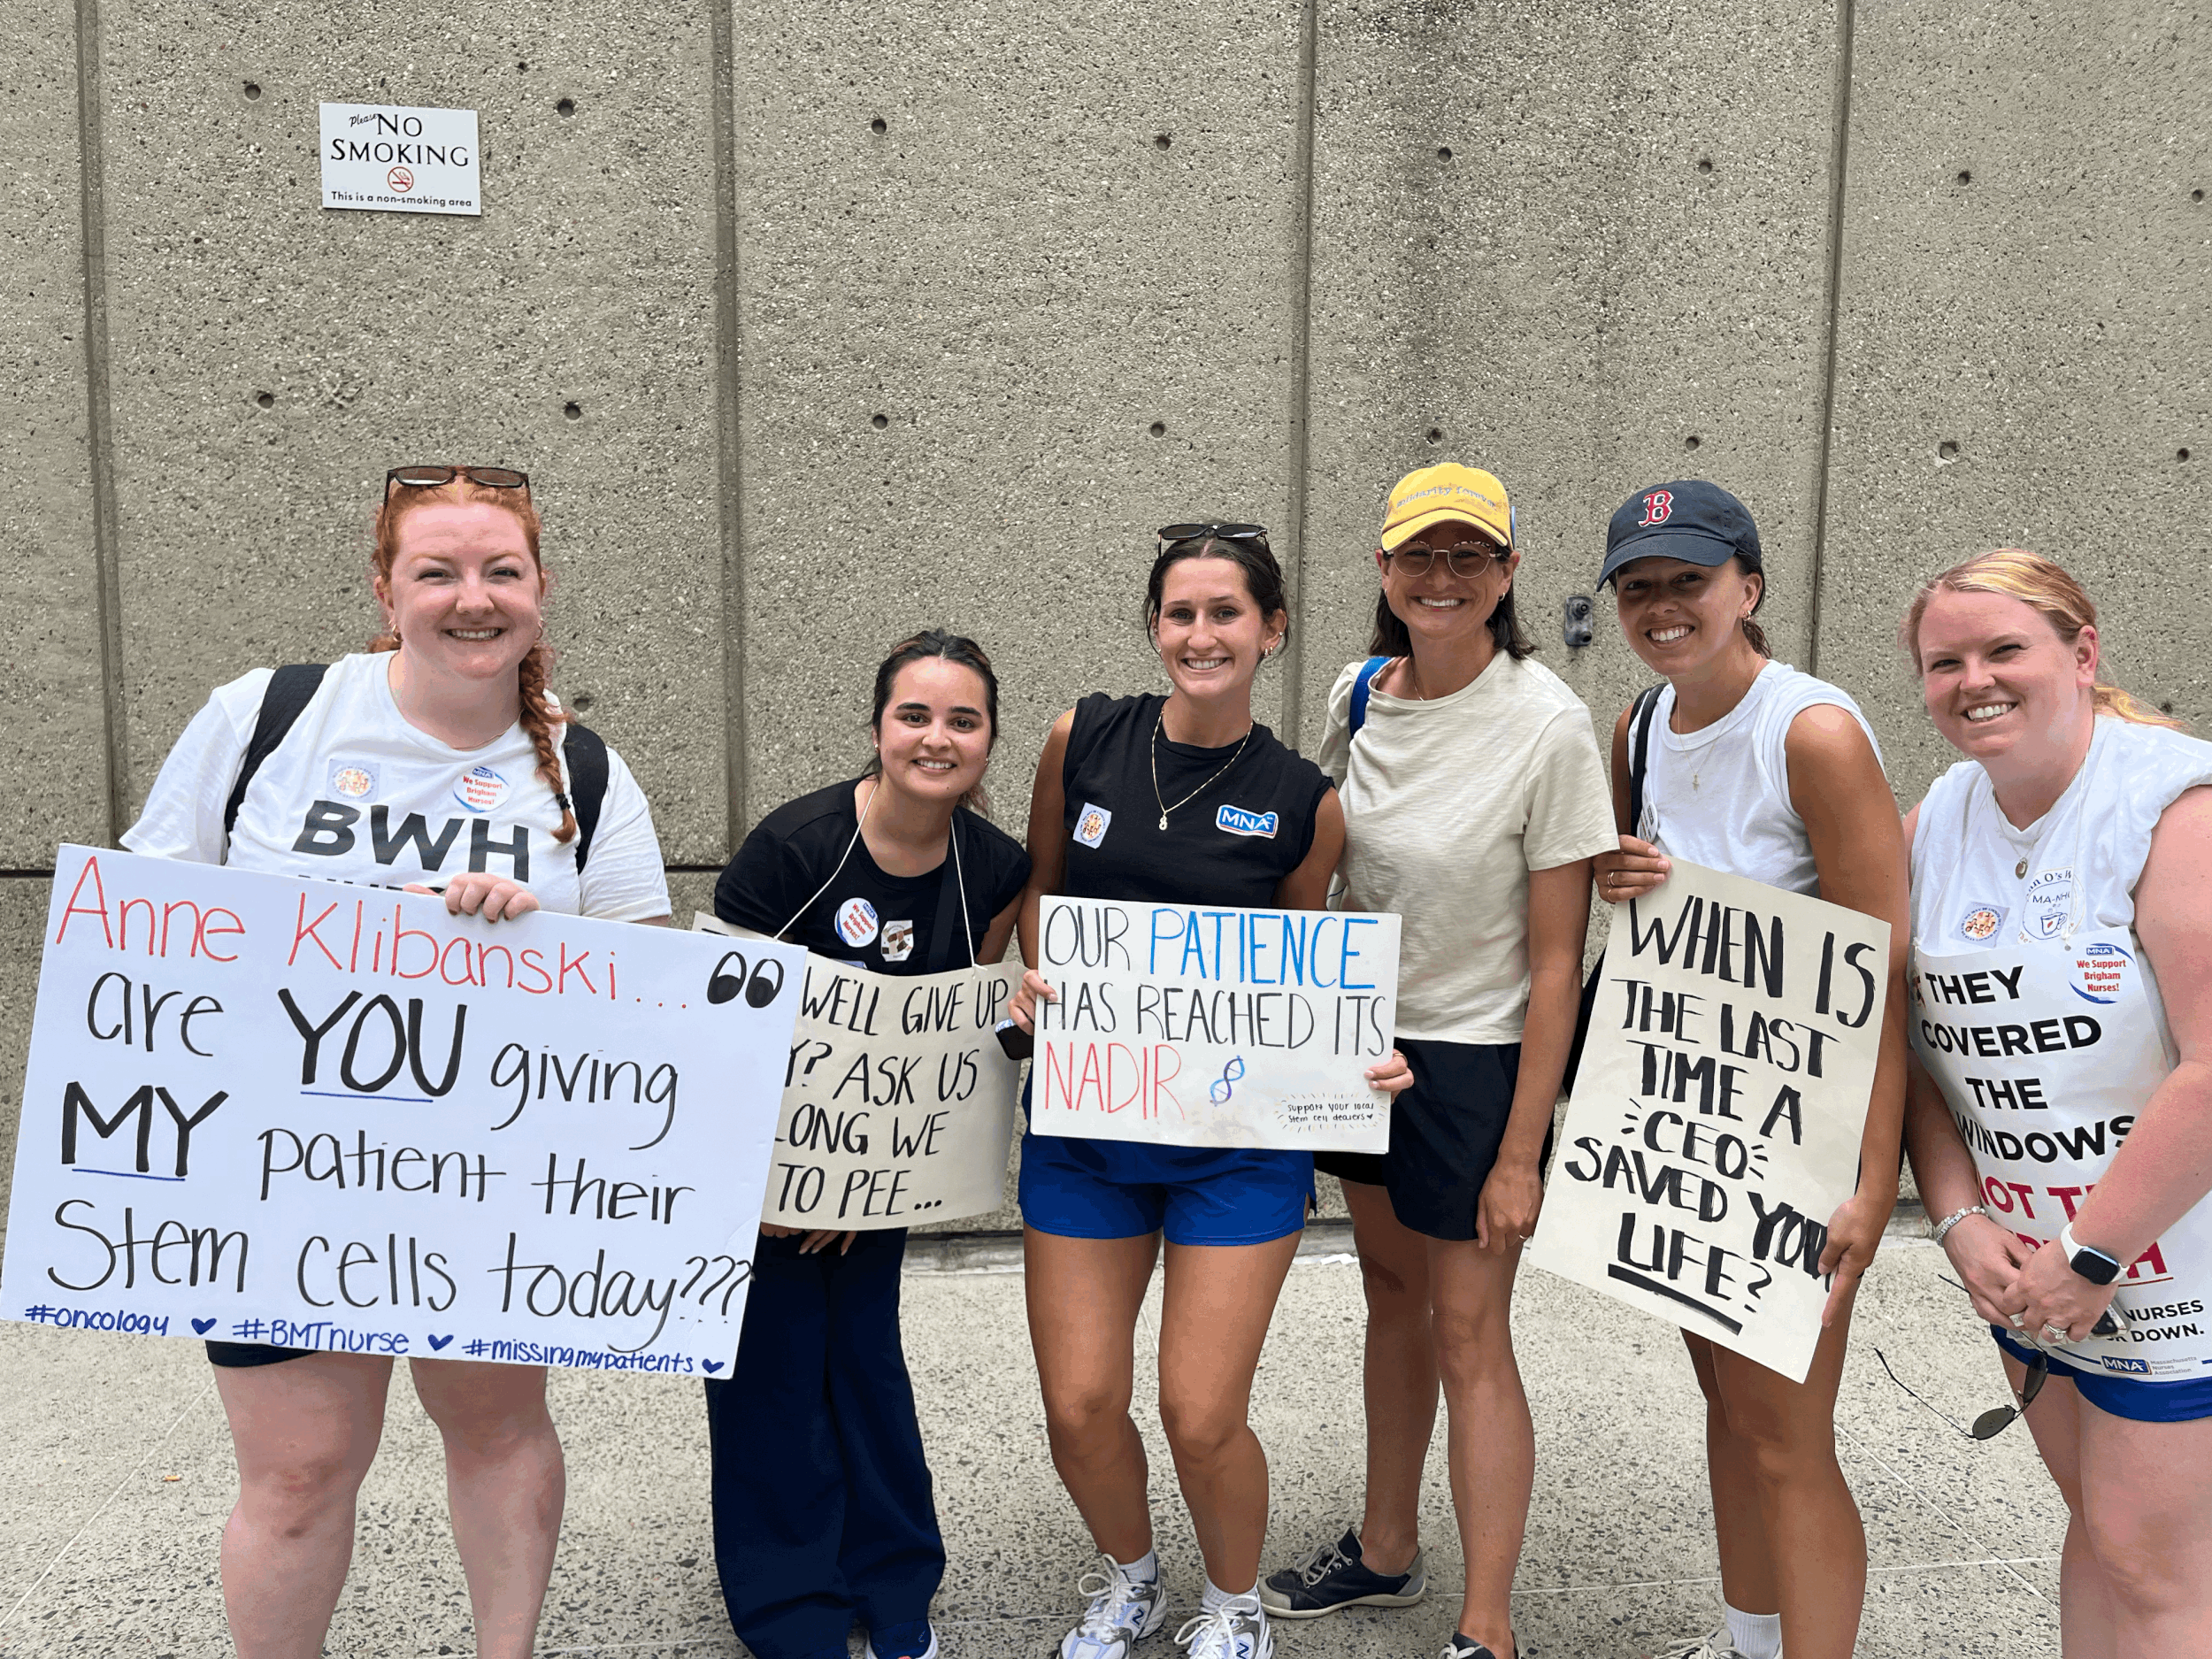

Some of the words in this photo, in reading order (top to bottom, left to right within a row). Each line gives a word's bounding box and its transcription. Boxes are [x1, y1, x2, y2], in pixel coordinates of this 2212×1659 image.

[349, 113, 378, 128] Please
[377, 113, 423, 137] NO
[330, 138, 470, 166] SMOKING
[331, 191, 354, 202] This
[356, 192, 364, 202] is
[377, 194, 447, 208] non-smoking
[449, 199, 472, 208] area
[1638, 489, 1675, 527] B
[463, 775, 473, 785] We
[474, 779, 503, 789] Support
[466, 786, 496, 797] Brigham
[468, 795, 495, 805] Nurses!
[1220, 809, 1272, 831] MNA
[291, 800, 529, 883] BWH
[57, 856, 246, 963] Anne
[849, 913, 866, 935] Brigham
[858, 911, 875, 933] Support
[842, 920, 860, 941] Nurses!
[1045, 904, 1131, 972] OUR
[1150, 908, 1379, 990] PATIENCE
[1629, 895, 1784, 998] WHEN
[1816, 931, 1877, 1029] IS
[2084, 971, 2121, 981] Brigham
[2092, 959, 2127, 969] Support
[1924, 965, 2024, 1005] THEY
[2087, 983, 2119, 992] Nurses!
[902, 982, 964, 1035] GIVE
[975, 978, 1010, 1029] UP
[1043, 979, 1117, 1033] HAS
[1137, 983, 1315, 1050] REACHED
[1334, 995, 1387, 1056] ITS
[1610, 979, 1708, 1045] THE
[1720, 1002, 1841, 1079] LAST
[1921, 1015, 2102, 1058] COVERED
[88, 972, 225, 1057] are
[278, 987, 467, 1097] YOU
[490, 1042, 679, 1151] giving
[833, 1052, 923, 1106] ASK
[938, 1048, 980, 1102] US
[1045, 1041, 1186, 1120] NADIR
[1328, 1102, 1349, 1113] your
[1625, 1040, 1751, 1122] TIME
[1759, 1084, 1803, 1146] A
[1964, 1077, 2049, 1110] THE
[775, 1103, 870, 1156] ONG
[893, 1110, 950, 1158] WE
[1313, 1114, 1328, 1123] cell
[62, 1081, 229, 1177] MY
[257, 1128, 507, 1202] patient
[531, 1152, 696, 1225] their
[1643, 1110, 1749, 1179] CEO
[777, 1163, 826, 1214] TO
[838, 1169, 943, 1219] PEE...
[1564, 1136, 1728, 1223] SAVED
[48, 1199, 249, 1293] Stem
[297, 1233, 457, 1308] cells
[1617, 1212, 1773, 1314] LIFE?
[25, 1304, 170, 1337] #oncology
[232, 1318, 410, 1355] #BMTnurse
[462, 1338, 694, 1373] #missingmypatients
[2131, 1323, 2205, 1343] DOWN.
[2103, 1357, 2145, 1371] MNA
